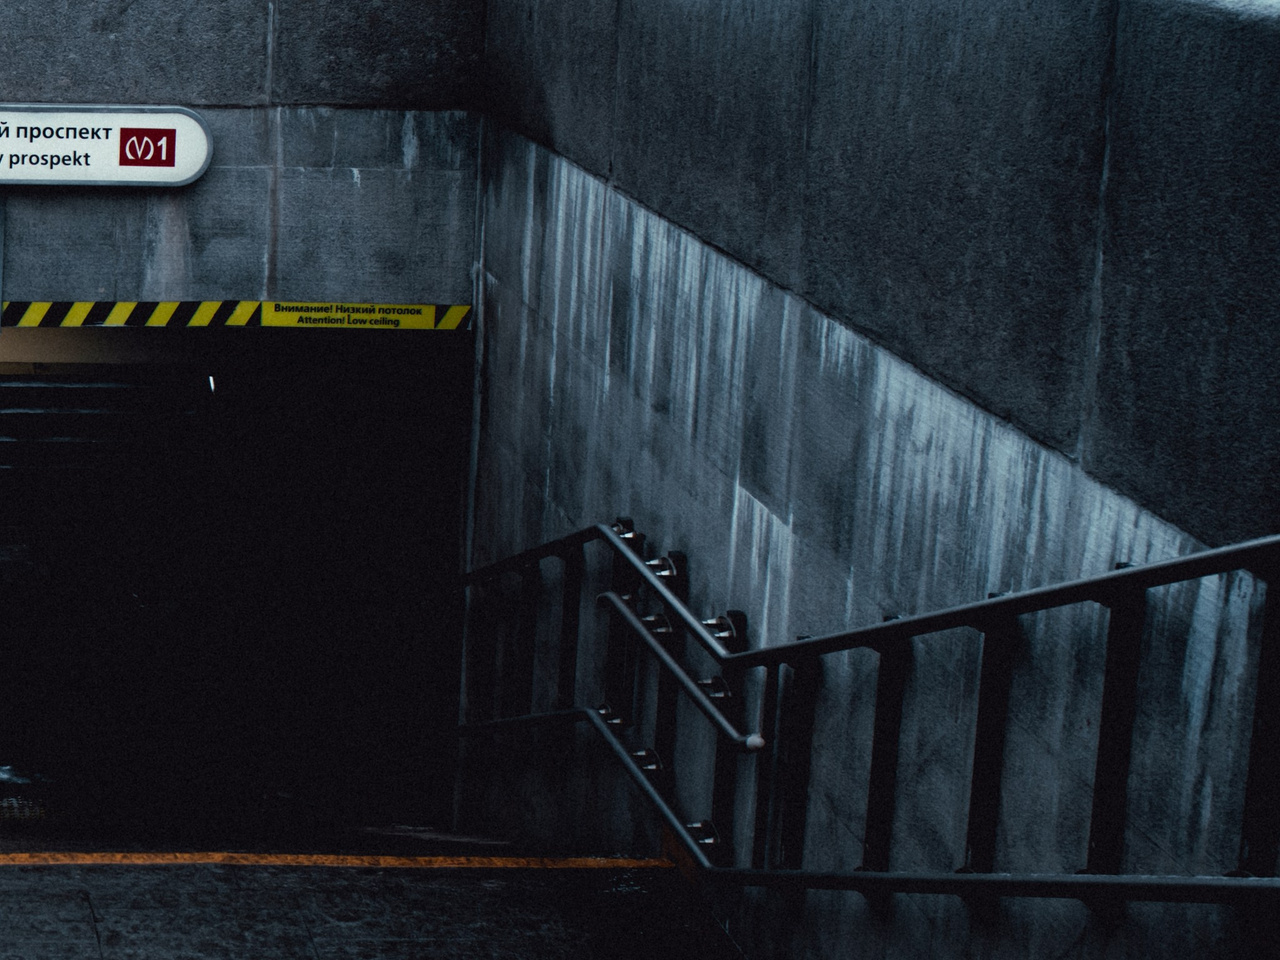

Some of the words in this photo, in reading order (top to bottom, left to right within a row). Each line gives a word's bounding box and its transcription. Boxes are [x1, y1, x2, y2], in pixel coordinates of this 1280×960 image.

[16, 126, 113, 143] проспект
[9, 150, 91, 169] prospekt
[274, 304, 334, 313] Внимание!
[335, 305, 376, 314] Низкий
[378, 308, 422, 316] потолок
[297, 315, 345, 324] Attention!
[347, 315, 367, 325] Low
[369, 316, 401, 327] ceiling
